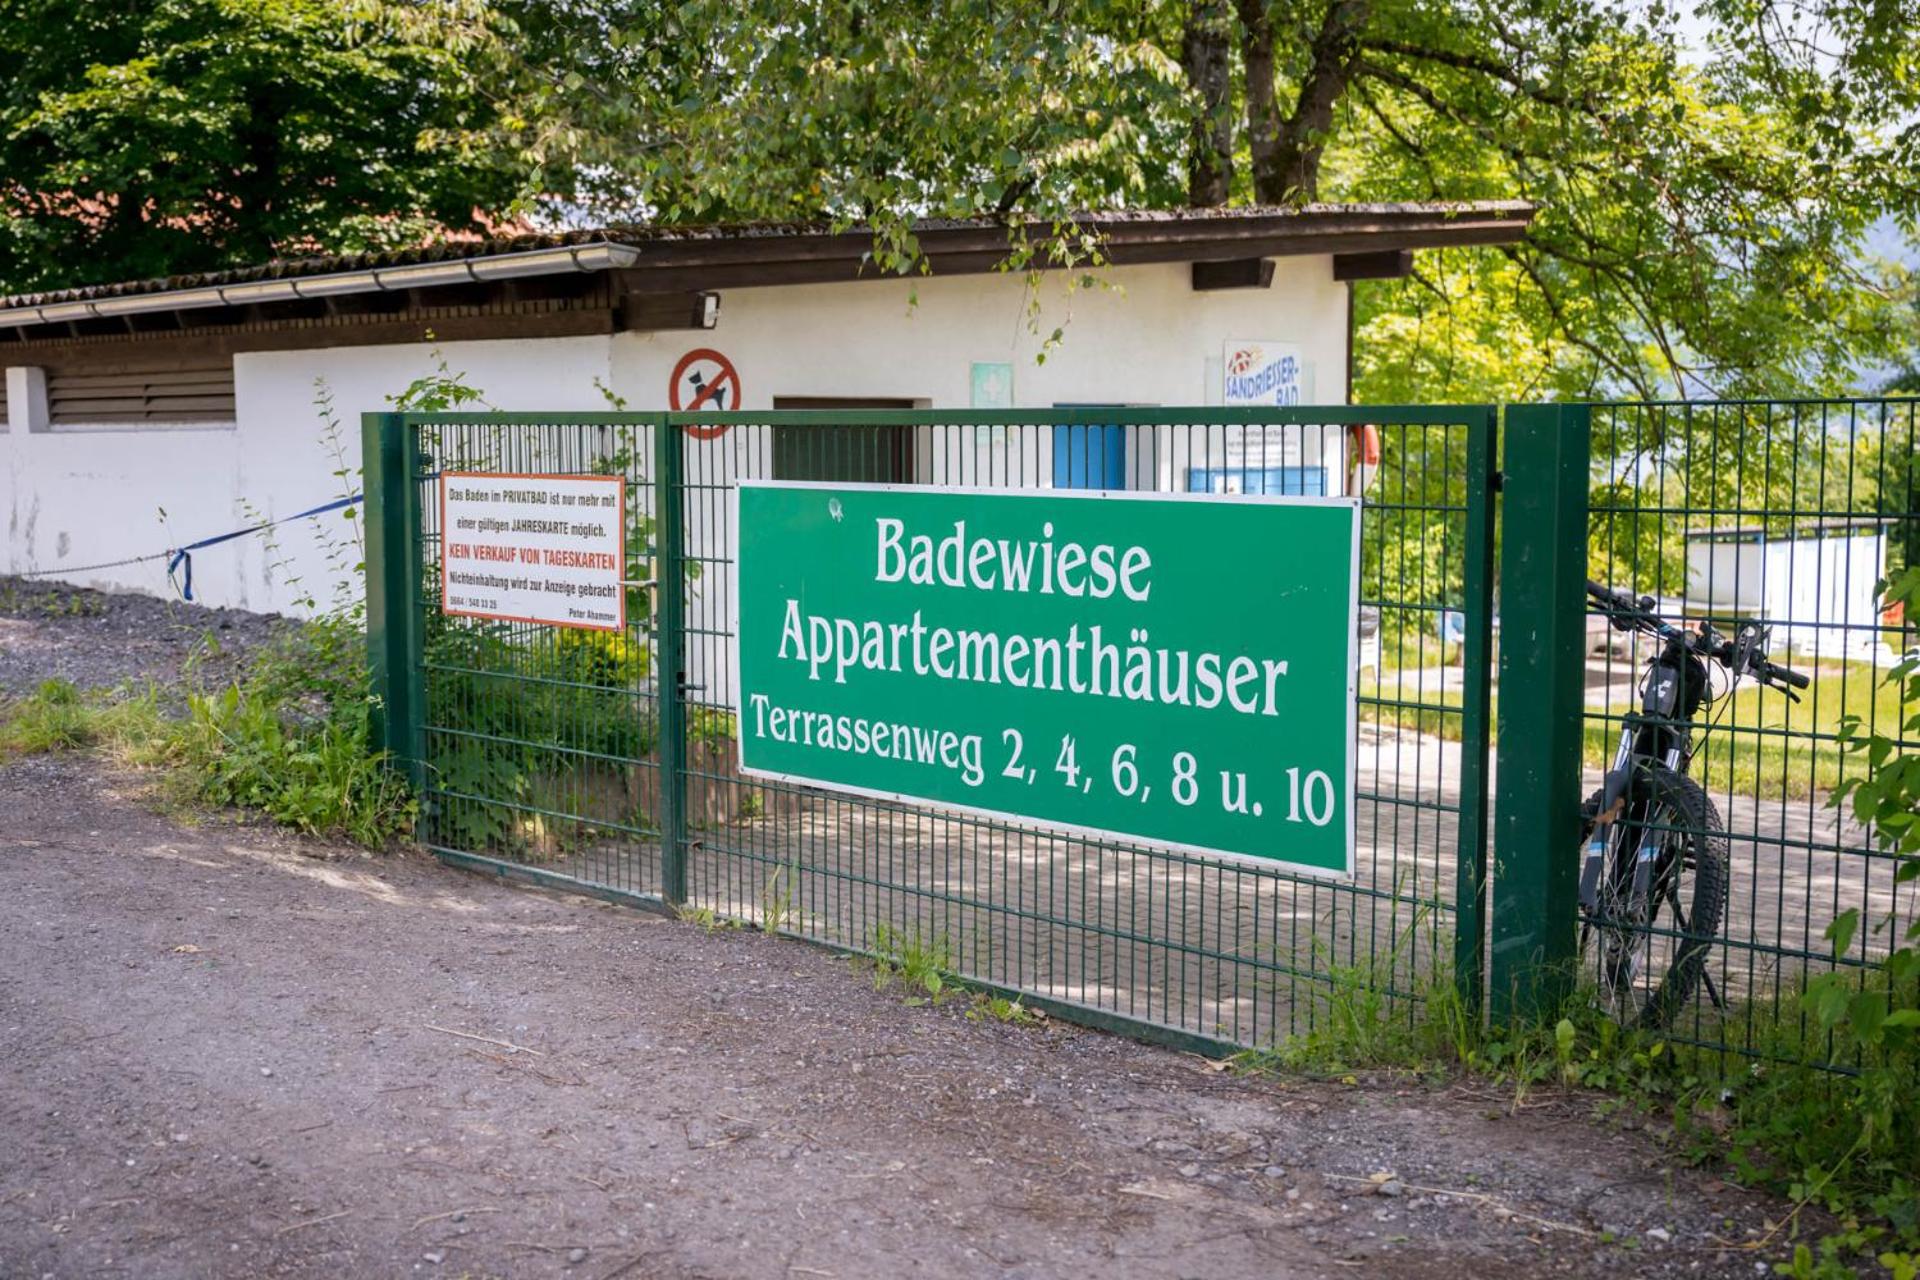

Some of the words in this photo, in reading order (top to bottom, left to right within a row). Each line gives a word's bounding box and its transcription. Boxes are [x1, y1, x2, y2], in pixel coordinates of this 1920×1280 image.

[1226, 355, 1299, 400] SANDRIESSER-
[1275, 385, 1299, 407] BAD
[449, 487, 464, 501] Das
[465, 488, 490, 502] Baden
[491, 490, 501, 503] im
[503, 490, 548, 505] PRIVATBAD
[550, 491, 560, 505] ist
[562, 495, 576, 506] nur
[578, 493, 600, 507] mehr
[601, 494, 616, 508] mit
[457, 516, 476, 530] einer
[478, 517, 509, 534] gültigen
[511, 518, 569, 535] JAHRESKARTE
[571, 522, 607, 539] möglich.
[449, 543, 471, 559] KEIN
[473, 544, 517, 562] VERKAUF
[519, 547, 540, 564] VON
[543, 549, 616, 570] TAGESKARTEN
[875, 517, 1152, 602] Badewiese
[449, 571, 509, 591] Nichteinhaltung
[511, 576, 528, 590] wird
[529, 580, 542, 592] zur
[544, 579, 576, 597] Anzeige
[578, 582, 617, 599] gebracht
[568, 607, 586, 619] Peter
[777, 599, 1289, 717] Appartementhäuser
[749, 693, 986, 788] Terrassenweg
[1001, 728, 1038, 786] 2,
[1054, 733, 1093, 794] 4,
[1111, 744, 1151, 803] 6,
[1171, 751, 1200, 806] 8
[1219, 770, 1264, 818] u.
[1285, 767, 1336, 827] 10
